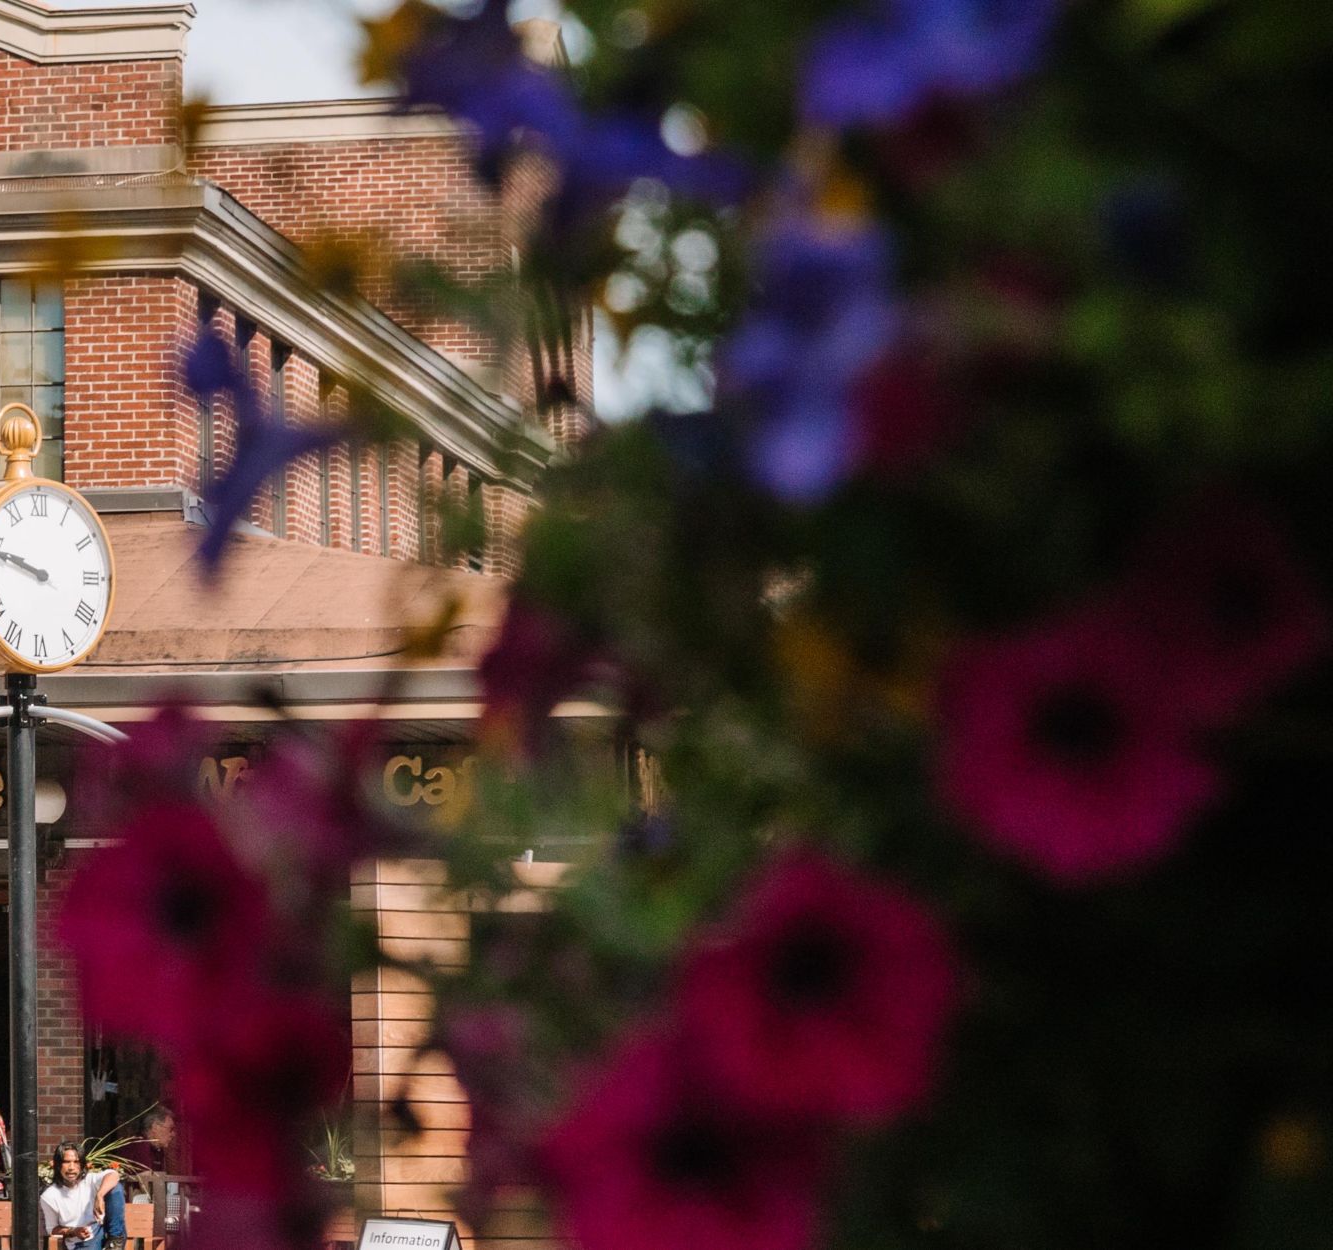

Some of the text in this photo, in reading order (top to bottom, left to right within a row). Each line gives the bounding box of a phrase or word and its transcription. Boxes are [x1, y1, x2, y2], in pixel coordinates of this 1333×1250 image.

[3, 499, 23, 527] XI
[30, 494, 48, 517] XII
[60, 507, 70, 526] I
[76, 534, 92, 552] II
[83, 571, 99, 586] III
[75, 599, 95, 626] IIII
[4, 620, 23, 650] VII
[34, 634, 47, 657] VI
[62, 628, 74, 650] V
[369, 1231, 440, 1247] Information
